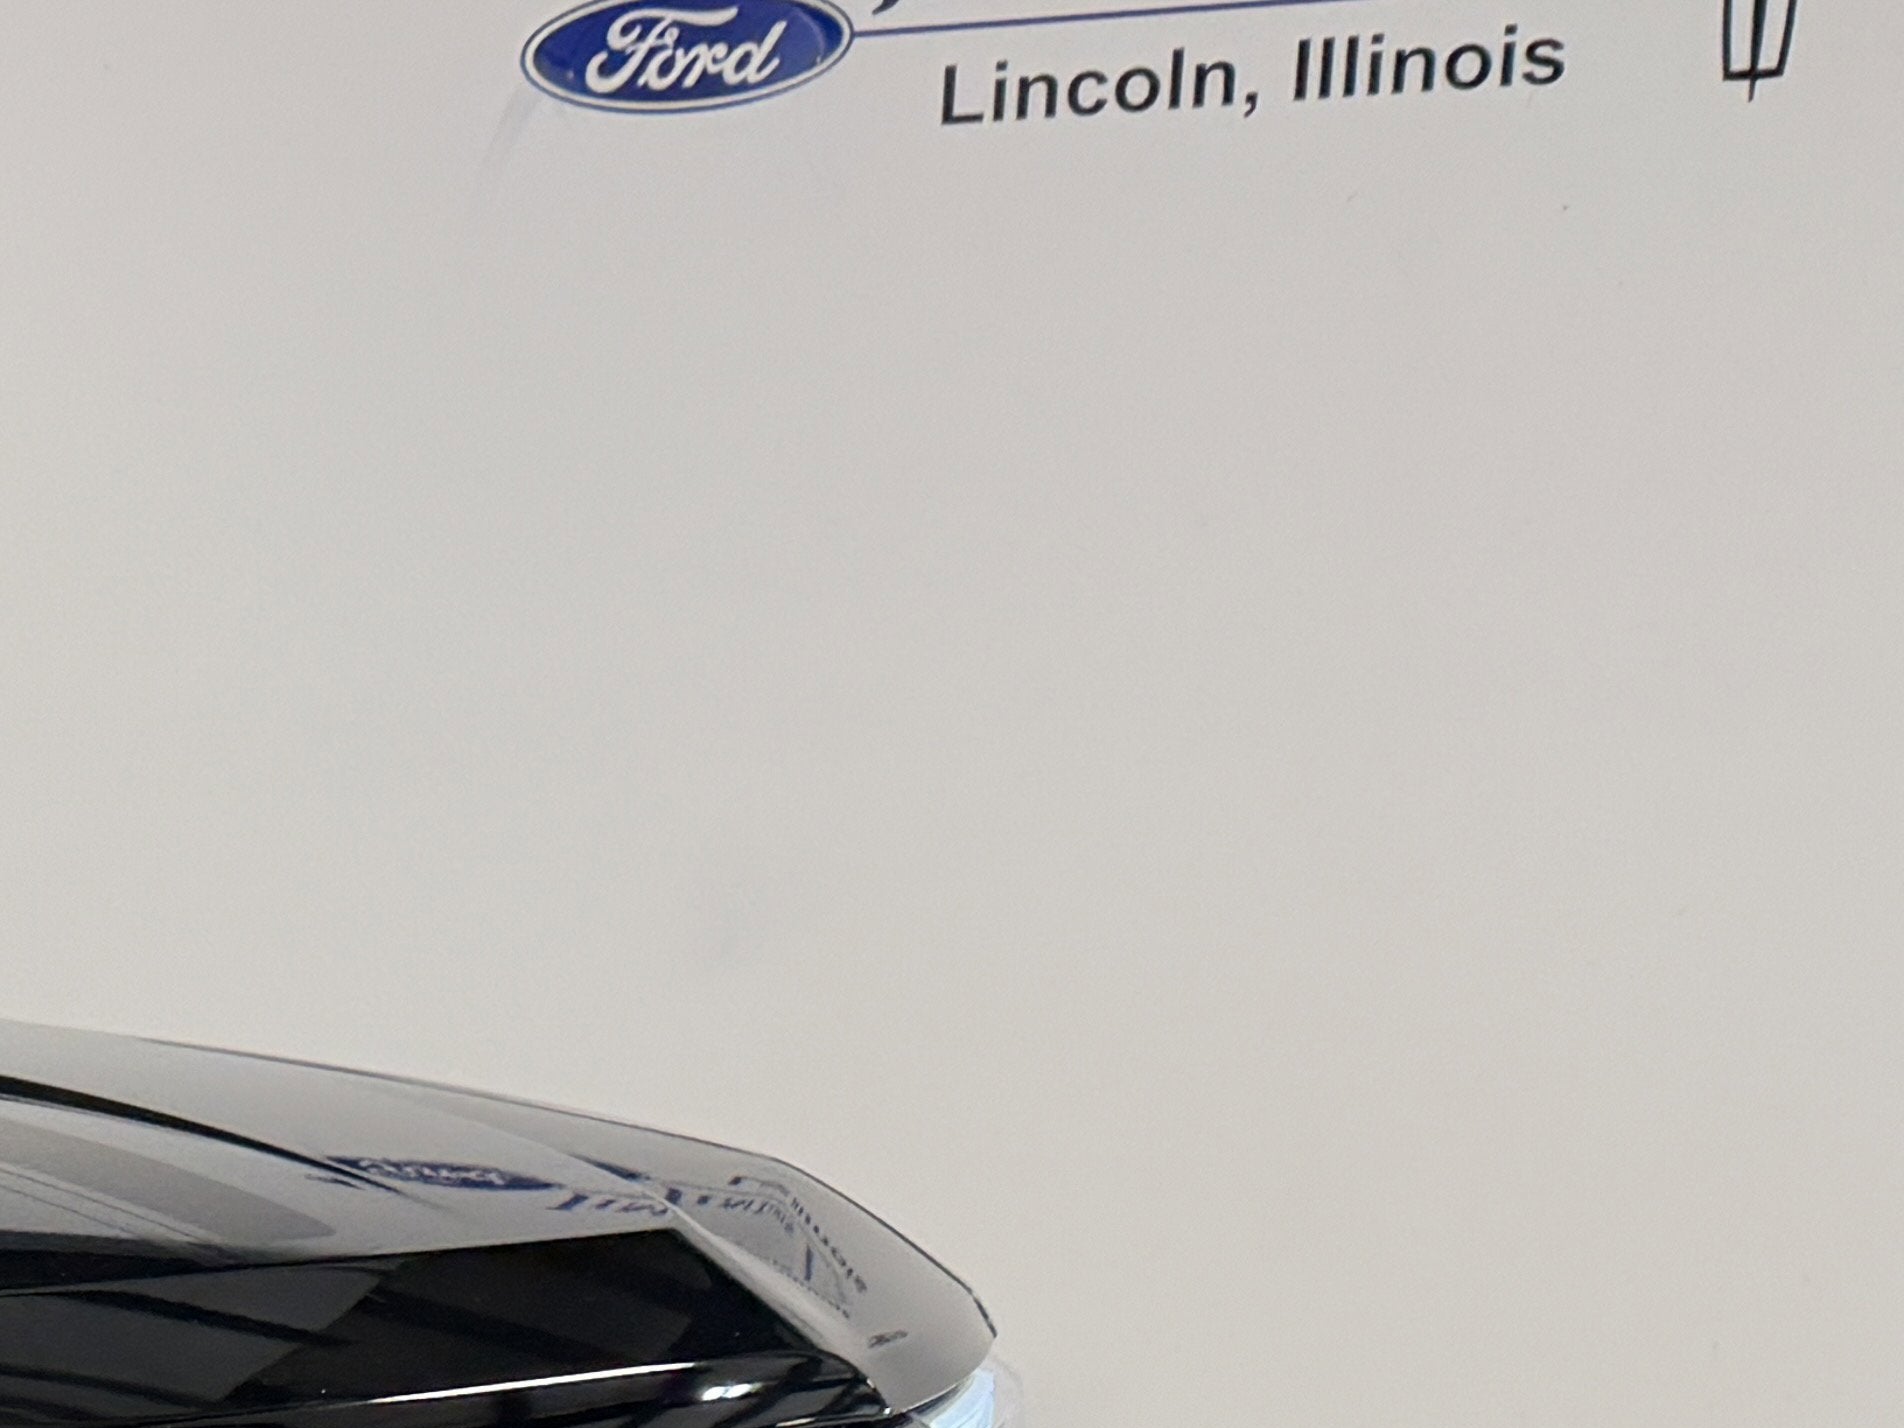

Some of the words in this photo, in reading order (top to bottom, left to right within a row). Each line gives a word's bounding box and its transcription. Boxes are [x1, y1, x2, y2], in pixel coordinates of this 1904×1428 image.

[584, 4, 789, 94] Ford
[940, 47, 1259, 126] Lincoln,
[1292, 24, 1566, 101] Illinois
